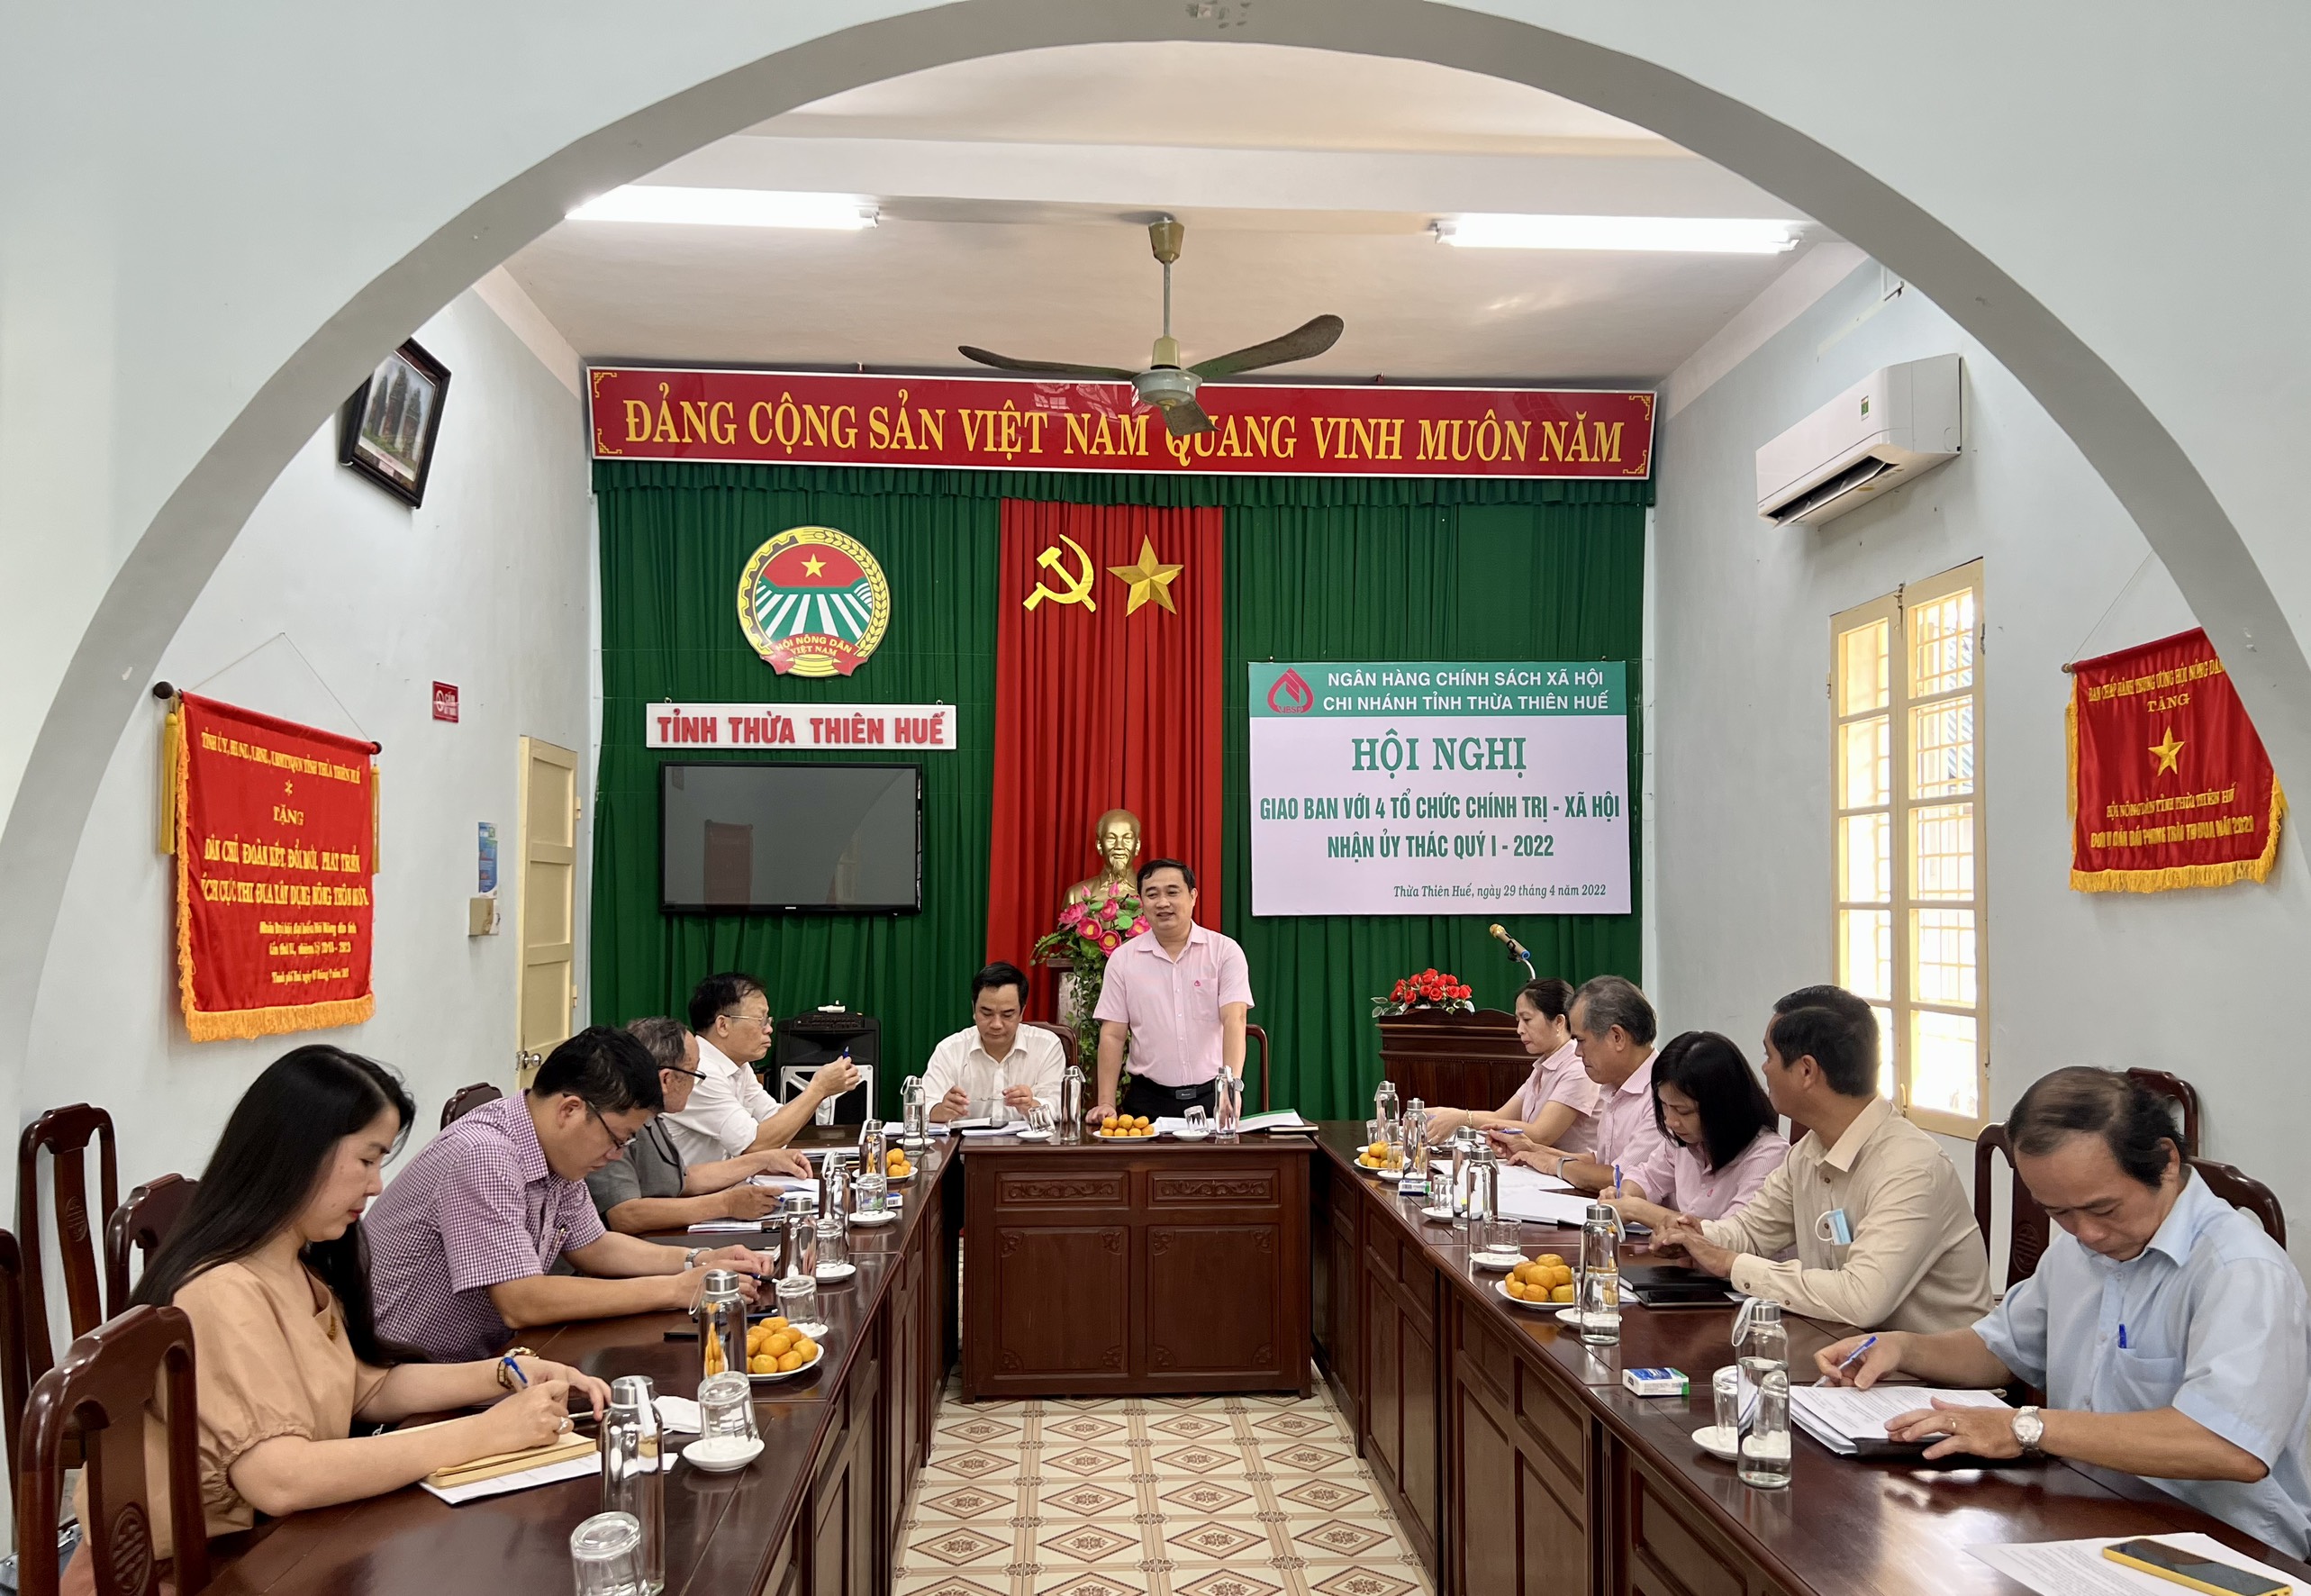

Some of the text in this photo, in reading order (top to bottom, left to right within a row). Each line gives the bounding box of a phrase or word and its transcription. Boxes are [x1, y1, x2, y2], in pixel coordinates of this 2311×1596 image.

[623, 382, 1624, 467] ĐẢNG CỘNG SẢN VIỆT NAM QUANG VINH MUÔN NĂM
[775, 634, 852, 653] HỘI NÔNG DÂN
[790, 646, 838, 656] VIỆT NAM
[1328, 669, 1603, 688] NGÂN HÀNG CHÍNH SÁCH XÃ HỘI
[1323, 690, 1609, 711] CHI NHÁNH TỈNH THỪA THIÊN HUẾ
[2147, 694, 2190, 712] TẶNG
[657, 708, 945, 744] TỈNH THỪA THIÊN HUẾ
[1351, 728, 1526, 780] HỘI NGHỊ
[274, 804, 304, 826] TẶNG
[1260, 797, 1299, 820] GIAO
[1304, 797, 1338, 820] BAN
[1344, 793, 1370, 819] VỚI
[1375, 797, 1385, 819] 4
[1391, 788, 1411, 819] TỔ
[1417, 793, 1460, 819] CHỨC
[1466, 793, 1517, 819] CHÍNH
[1522, 796, 1547, 822] TRỊ
[1564, 792, 1586, 818] XÃ
[1592, 792, 1619, 822] HỘI
[1328, 831, 1373, 863] NHẬN
[1380, 829, 1400, 857] ỦY
[1406, 831, 1448, 857] THÁC
[1454, 830, 1485, 857] QUÝ
[1491, 836, 1495, 856] I
[1514, 835, 1554, 857] 2022
[1394, 882, 1606, 900] Thừa Thiên Huế, ngày 29 tháng 4 năm 2022
